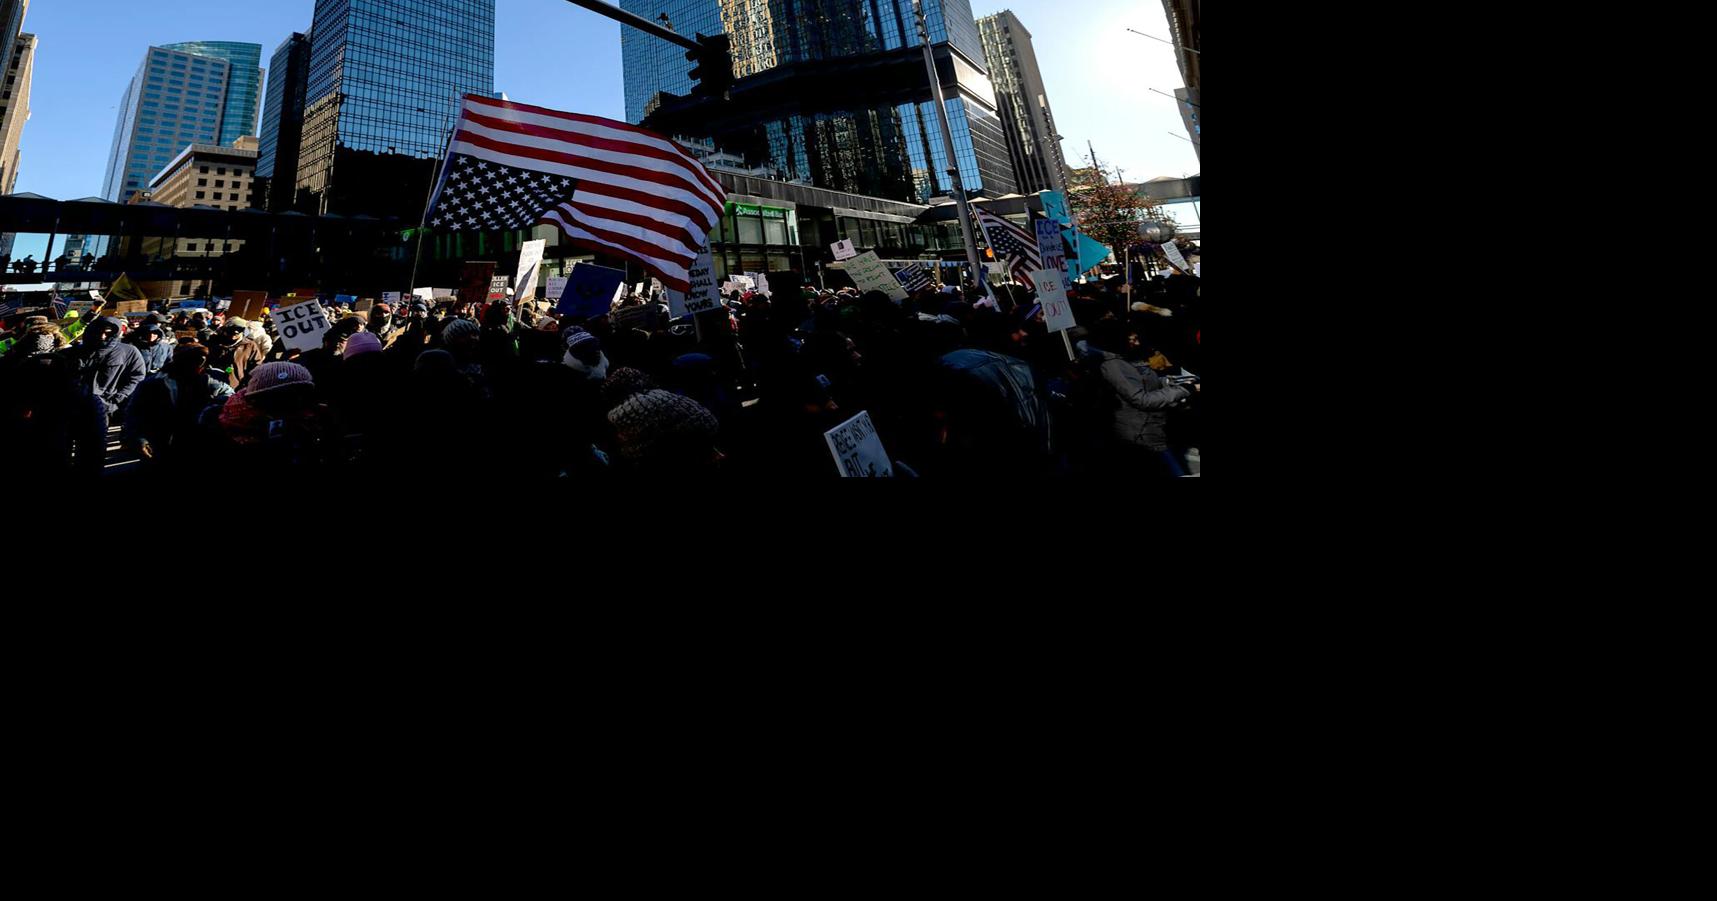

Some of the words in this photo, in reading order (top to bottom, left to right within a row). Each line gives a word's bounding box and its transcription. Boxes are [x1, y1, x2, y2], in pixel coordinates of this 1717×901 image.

[1037, 220, 1059, 235] ICE
[276, 303, 319, 323] ICE
[284, 316, 324, 338] OUT
